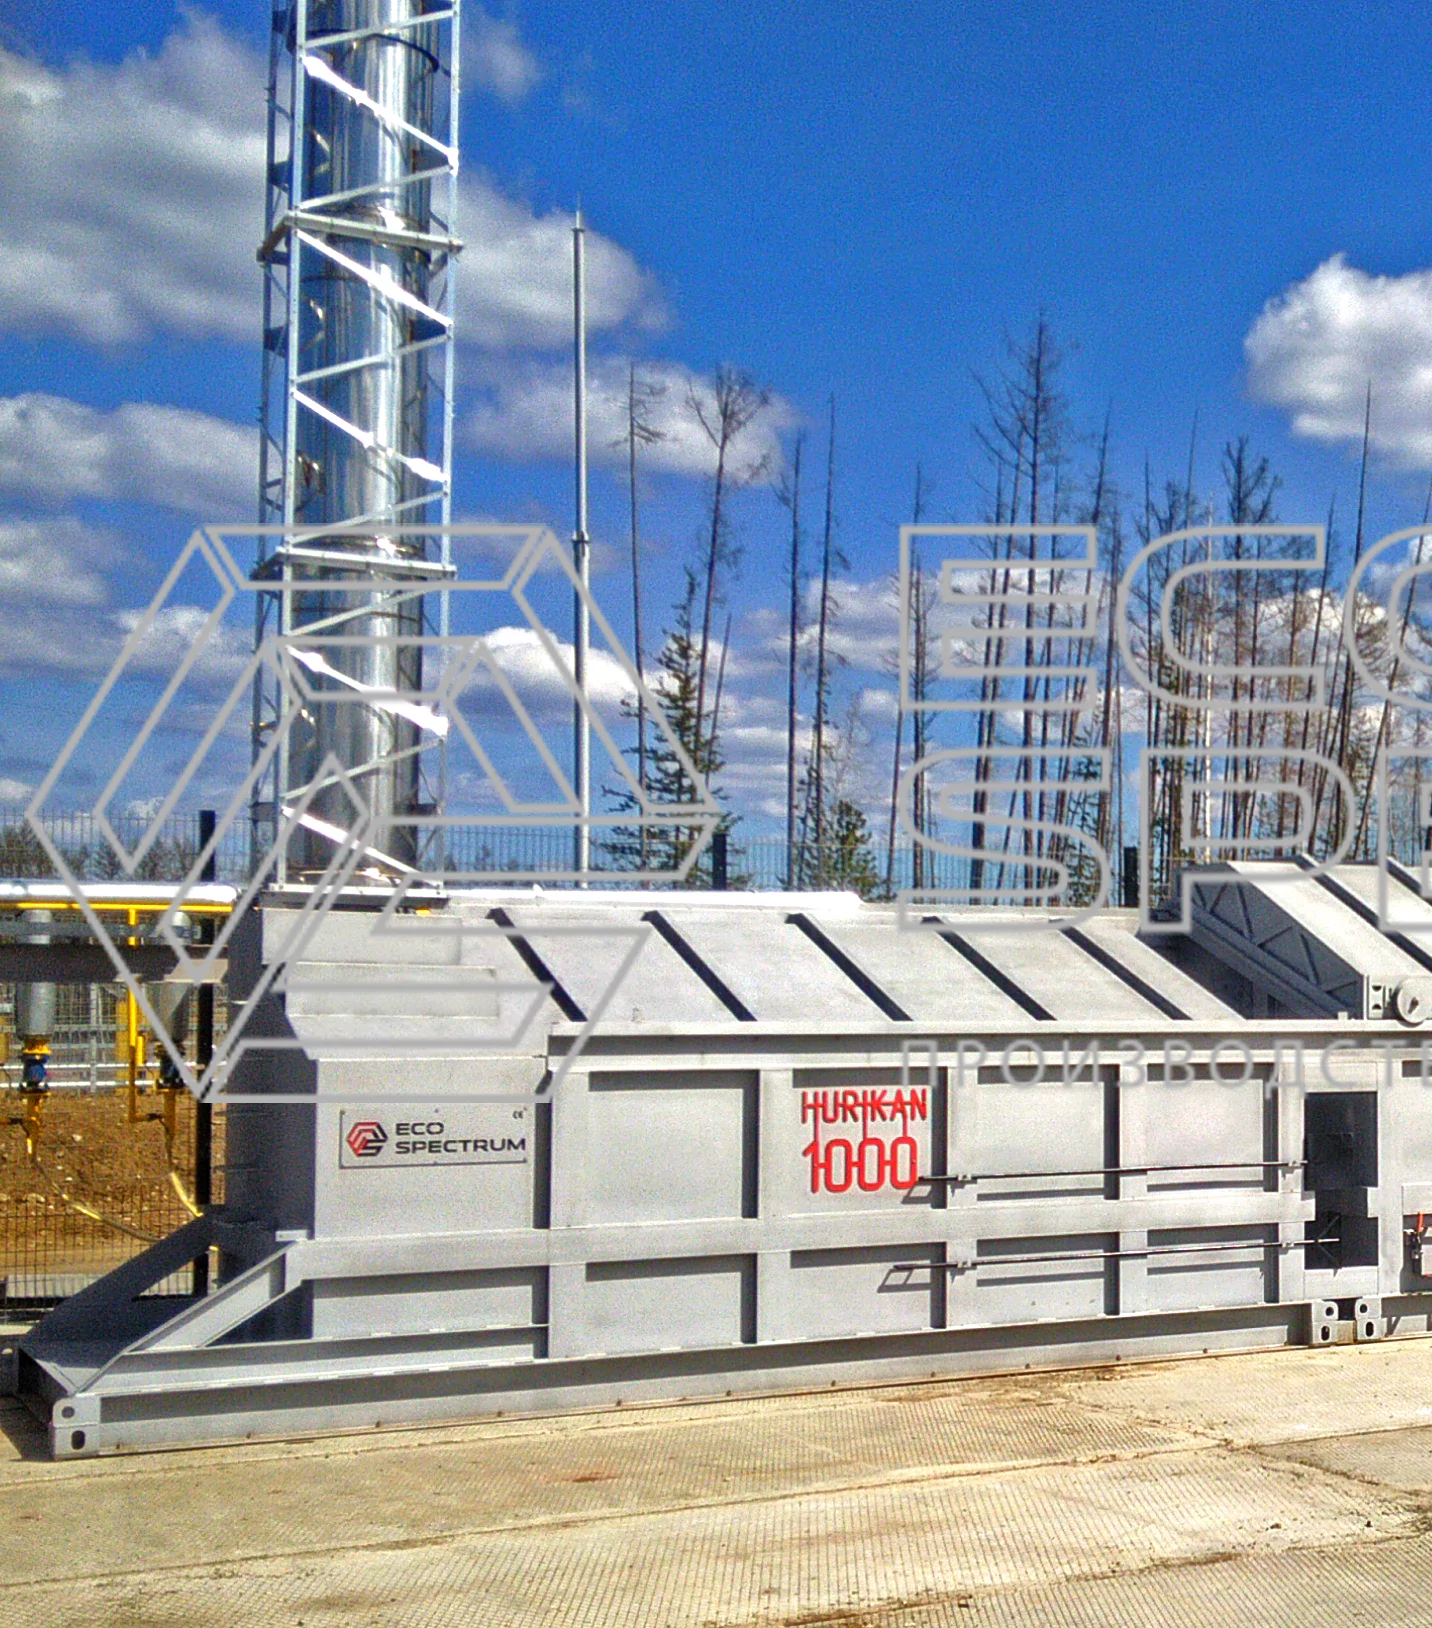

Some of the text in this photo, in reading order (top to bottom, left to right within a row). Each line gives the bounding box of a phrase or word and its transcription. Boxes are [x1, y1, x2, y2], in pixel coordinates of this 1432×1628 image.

[801, 1087, 928, 1124] HURIKAN
[395, 1121, 445, 1136] ECO
[394, 1138, 527, 1155] SPECTRUM
[802, 1136, 919, 1194] 1000
